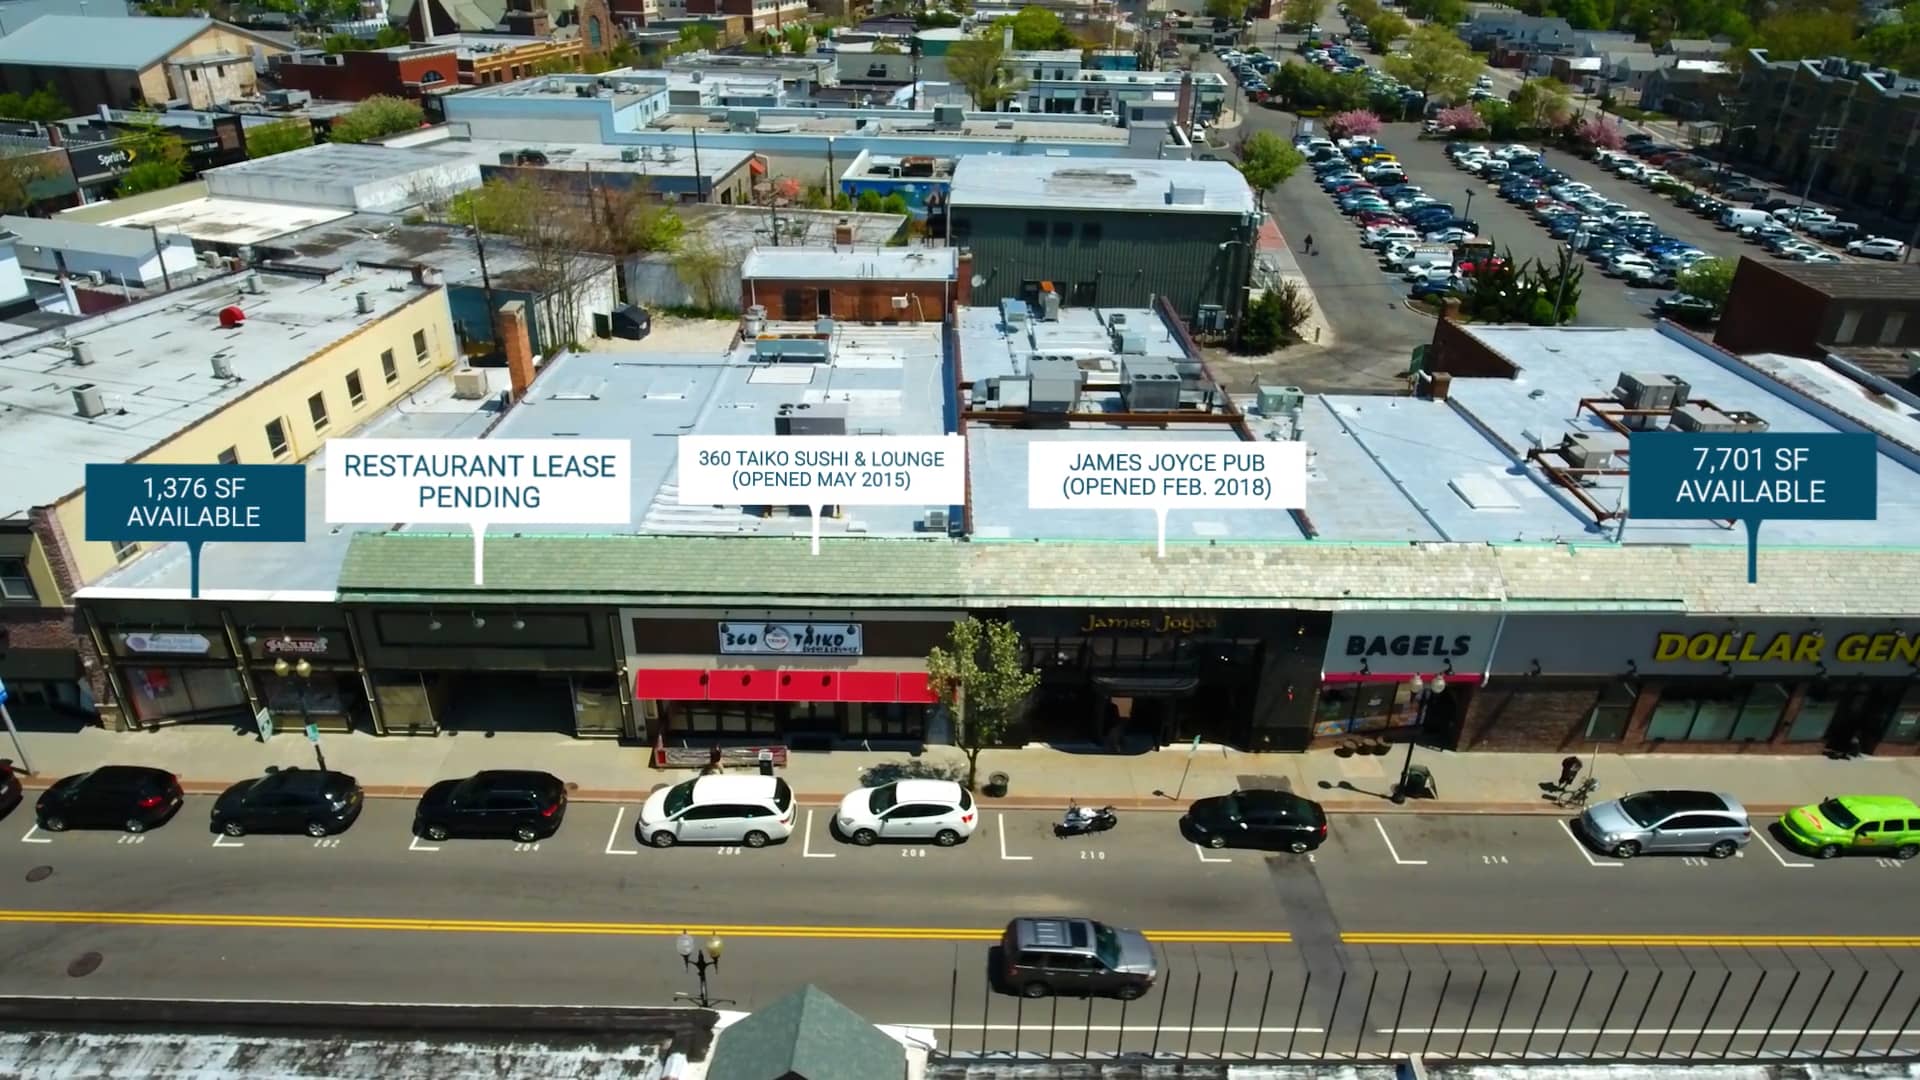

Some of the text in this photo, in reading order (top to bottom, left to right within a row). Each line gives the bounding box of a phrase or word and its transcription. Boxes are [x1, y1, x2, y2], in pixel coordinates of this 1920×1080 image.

[97, 150, 127, 166] Sprint
[1081, 613, 1217, 634] James Joyce
[726, 633, 758, 646] 360
[793, 633, 845, 647] TAIKO
[1346, 635, 1471, 657] BAGELS
[1654, 632, 1827, 663] DOLLAR
[1080, 850, 1105, 860] 210
